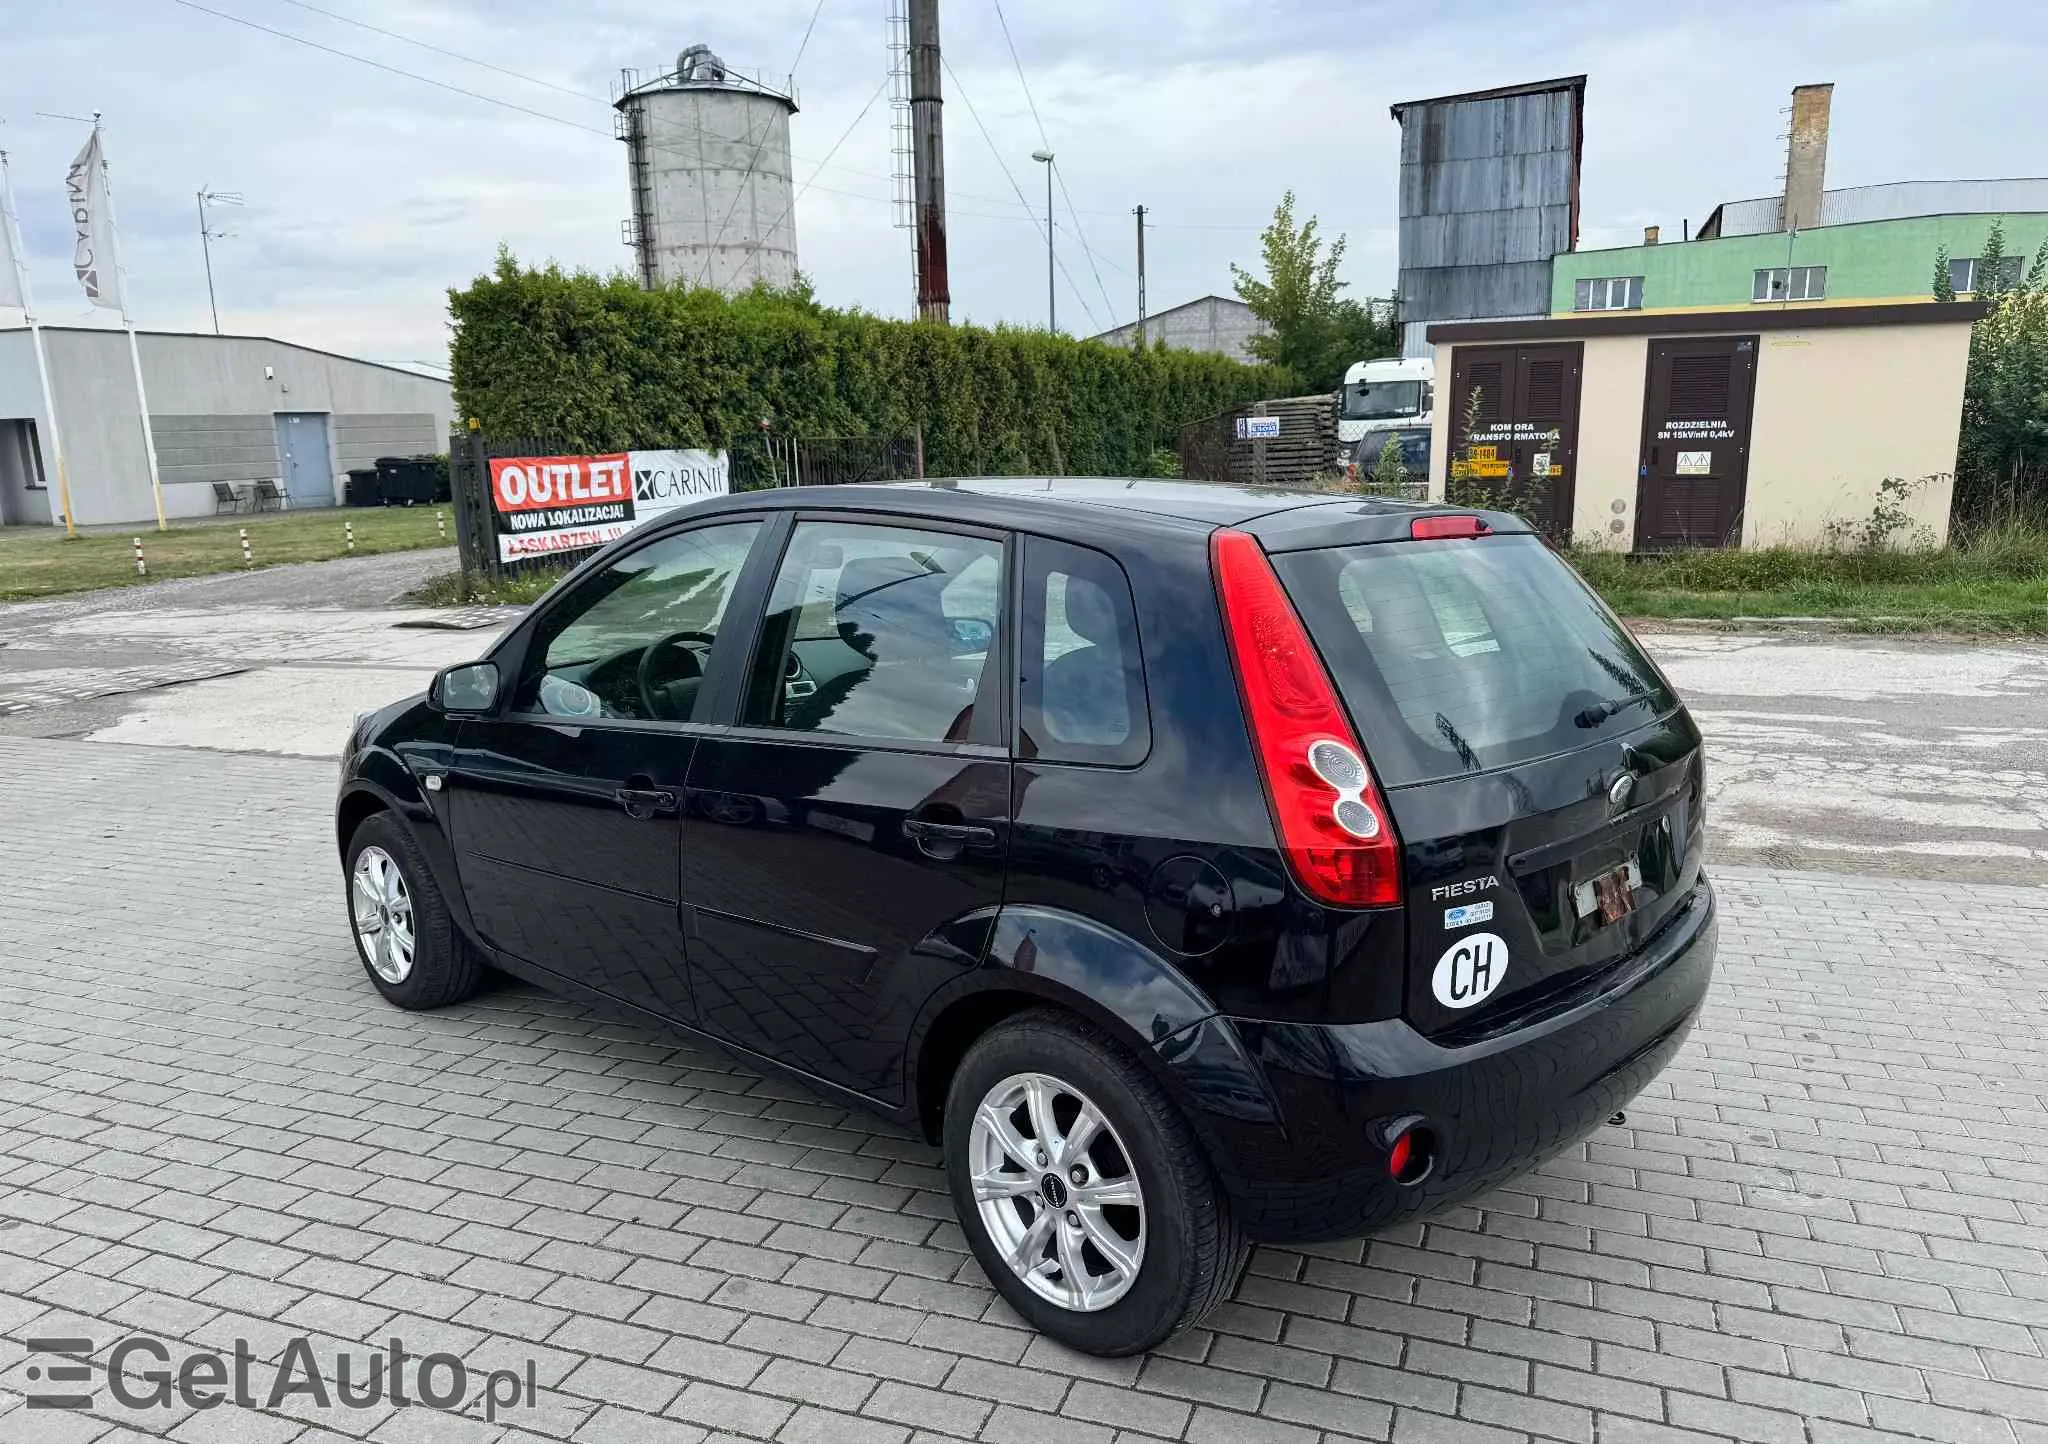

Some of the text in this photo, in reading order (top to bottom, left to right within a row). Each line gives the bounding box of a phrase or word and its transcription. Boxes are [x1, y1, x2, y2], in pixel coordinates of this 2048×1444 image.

[1657, 431, 1671, 439] SN
[1710, 430, 1734, 439] 0,4kV
[1666, 420, 1728, 430] ROZDZIELNIA
[500, 461, 625, 506] OUTLET
[511, 504, 624, 530] NOWA LOKALIZACJA!
[1432, 875, 1500, 901] FIESTA
[1451, 941, 1493, 1000] CH
